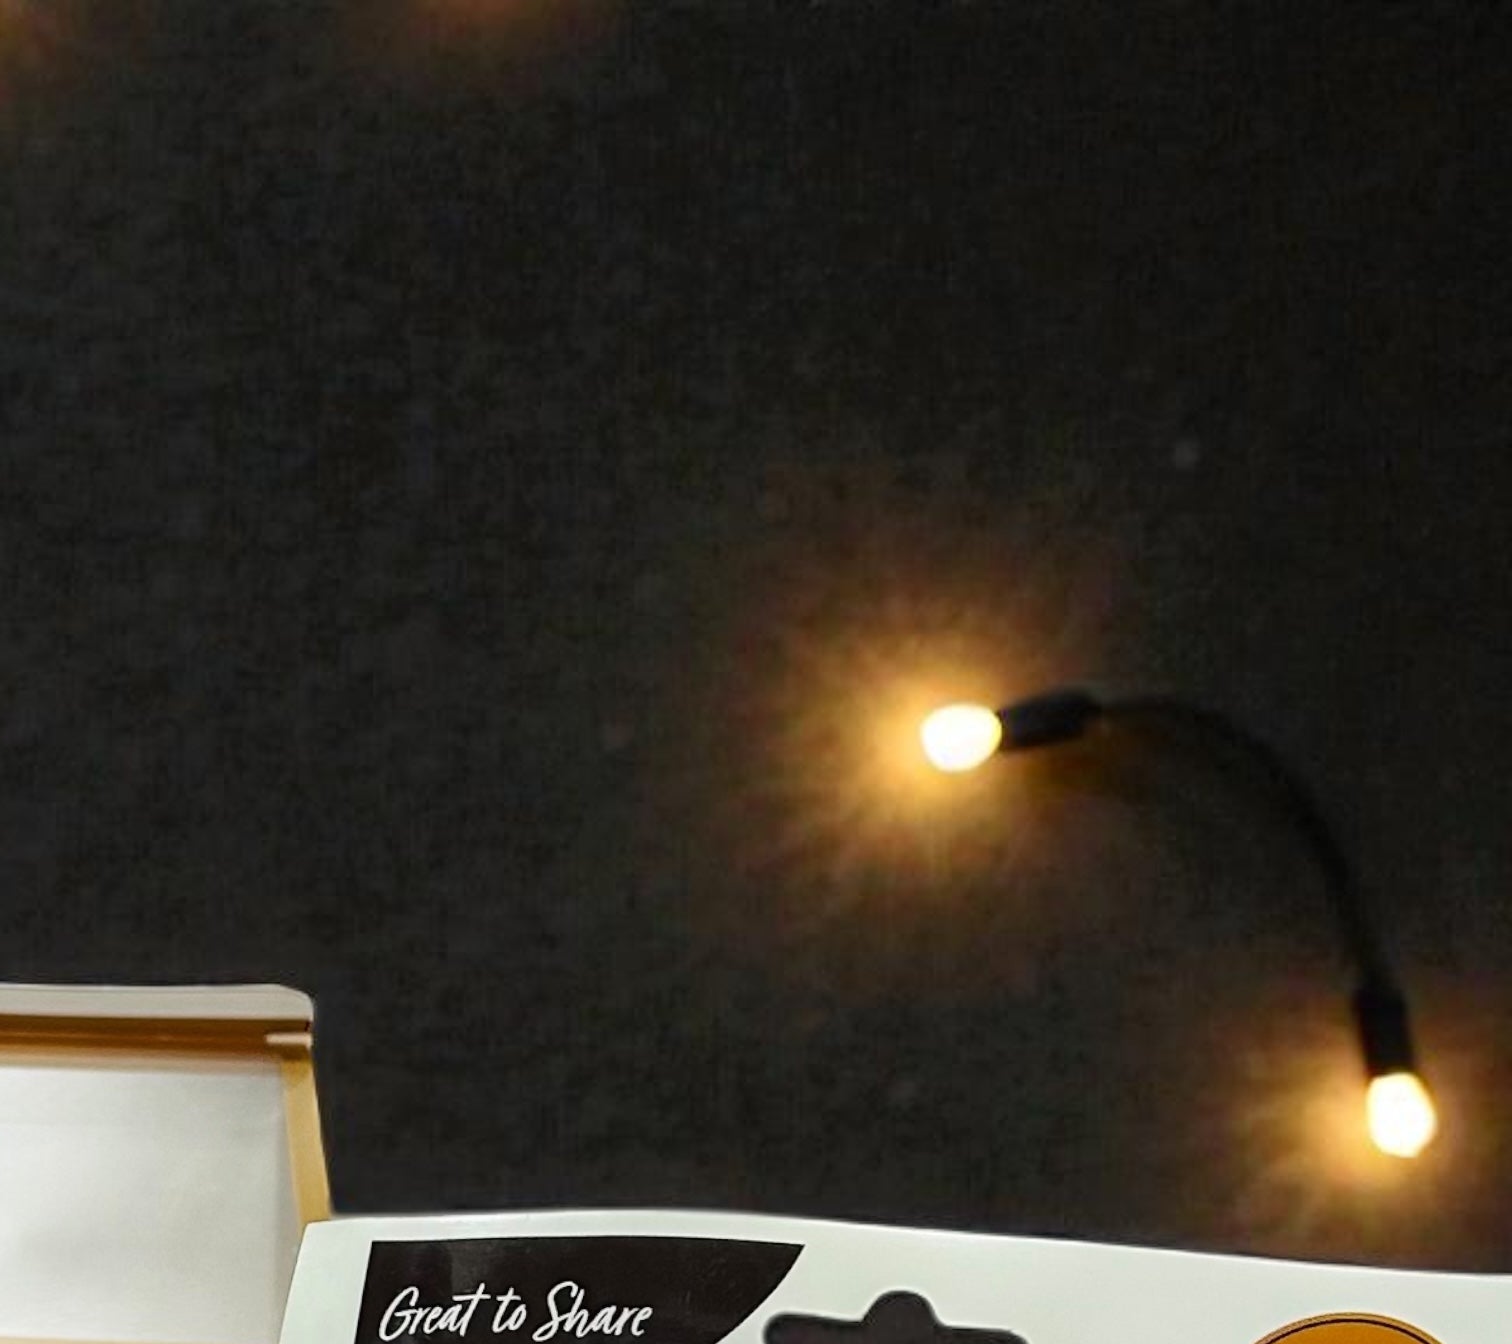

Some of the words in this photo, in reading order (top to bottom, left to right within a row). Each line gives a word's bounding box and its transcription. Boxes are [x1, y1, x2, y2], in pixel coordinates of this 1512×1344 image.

[378, 1282, 491, 1341] Great
[492, 1286, 527, 1333] to
[532, 1280, 654, 1342] Share
